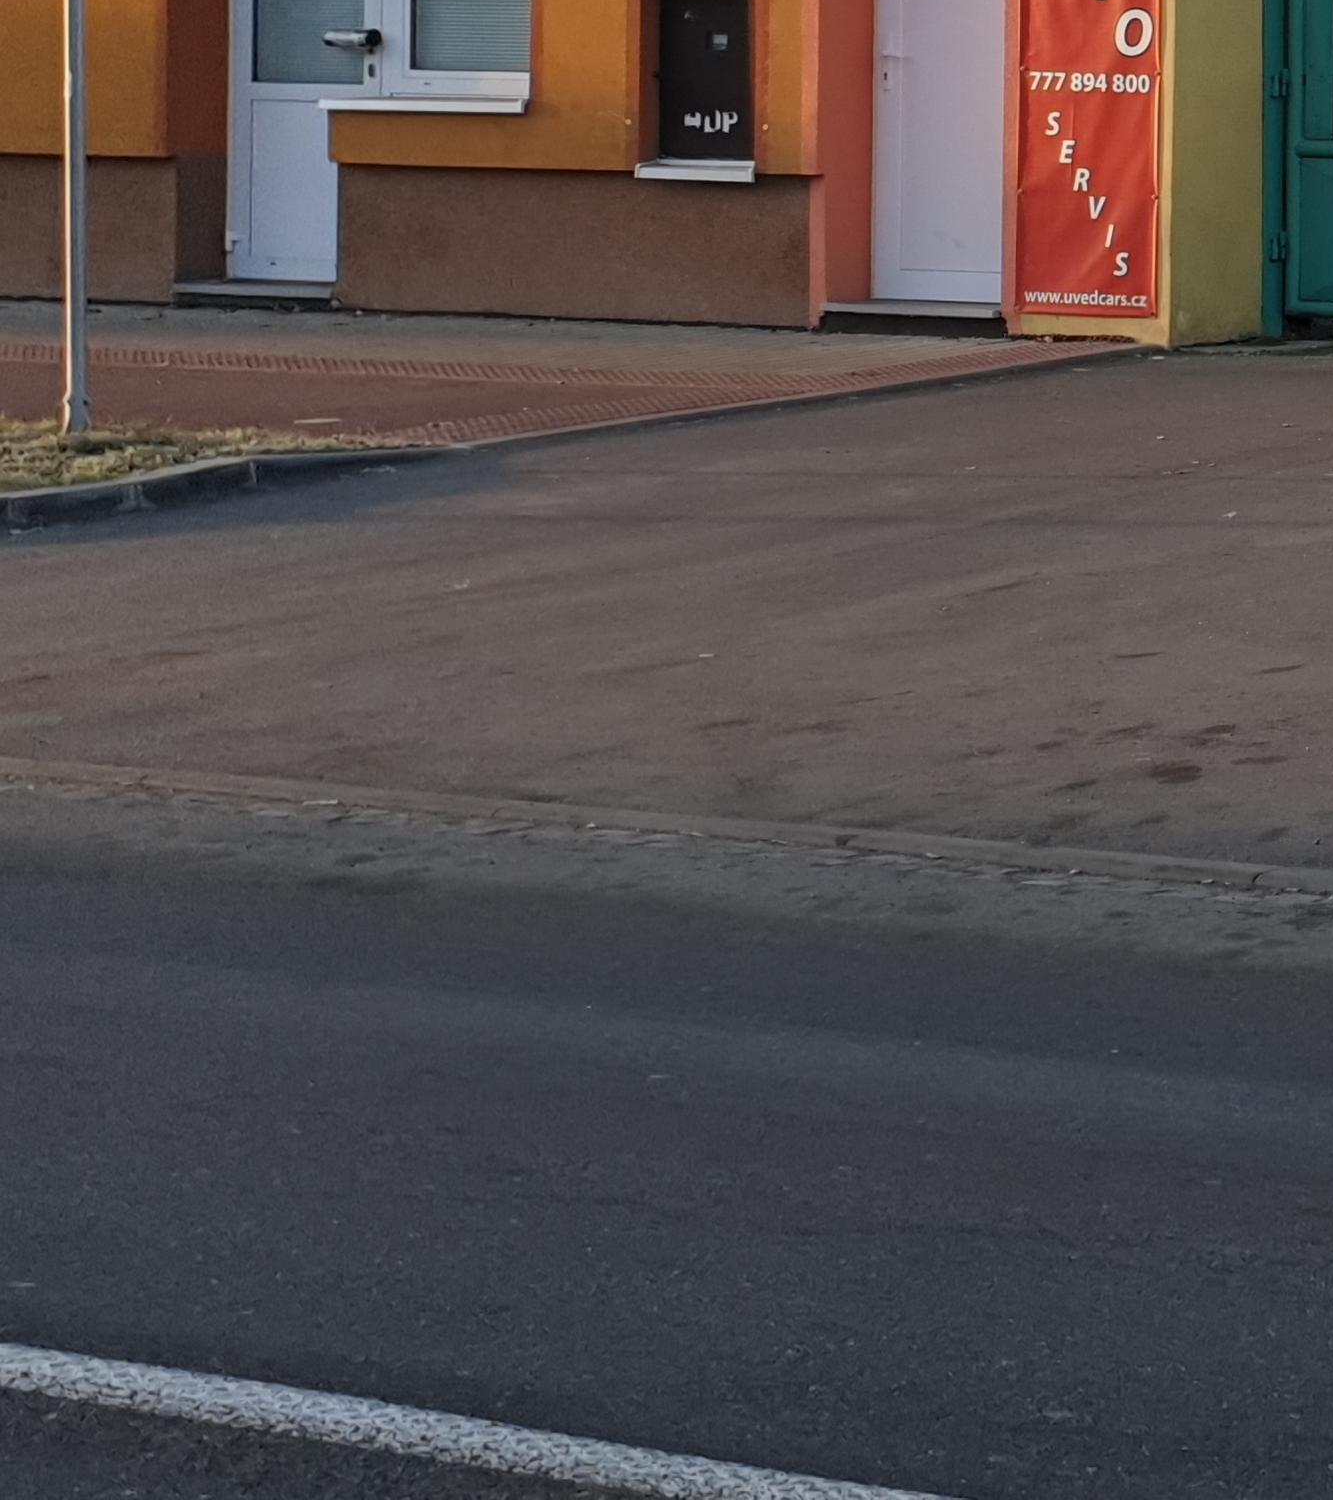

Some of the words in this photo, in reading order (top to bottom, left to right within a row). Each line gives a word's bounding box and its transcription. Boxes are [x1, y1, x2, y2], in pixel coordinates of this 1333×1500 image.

[1029, 71, 1066, 92] 777
[1070, 71, 1108, 93] 894
[1112, 73, 1151, 95] 800
[1045, 111, 1130, 277] SERVIS
[1025, 289, 1147, 309] www.uvedcars.cz
